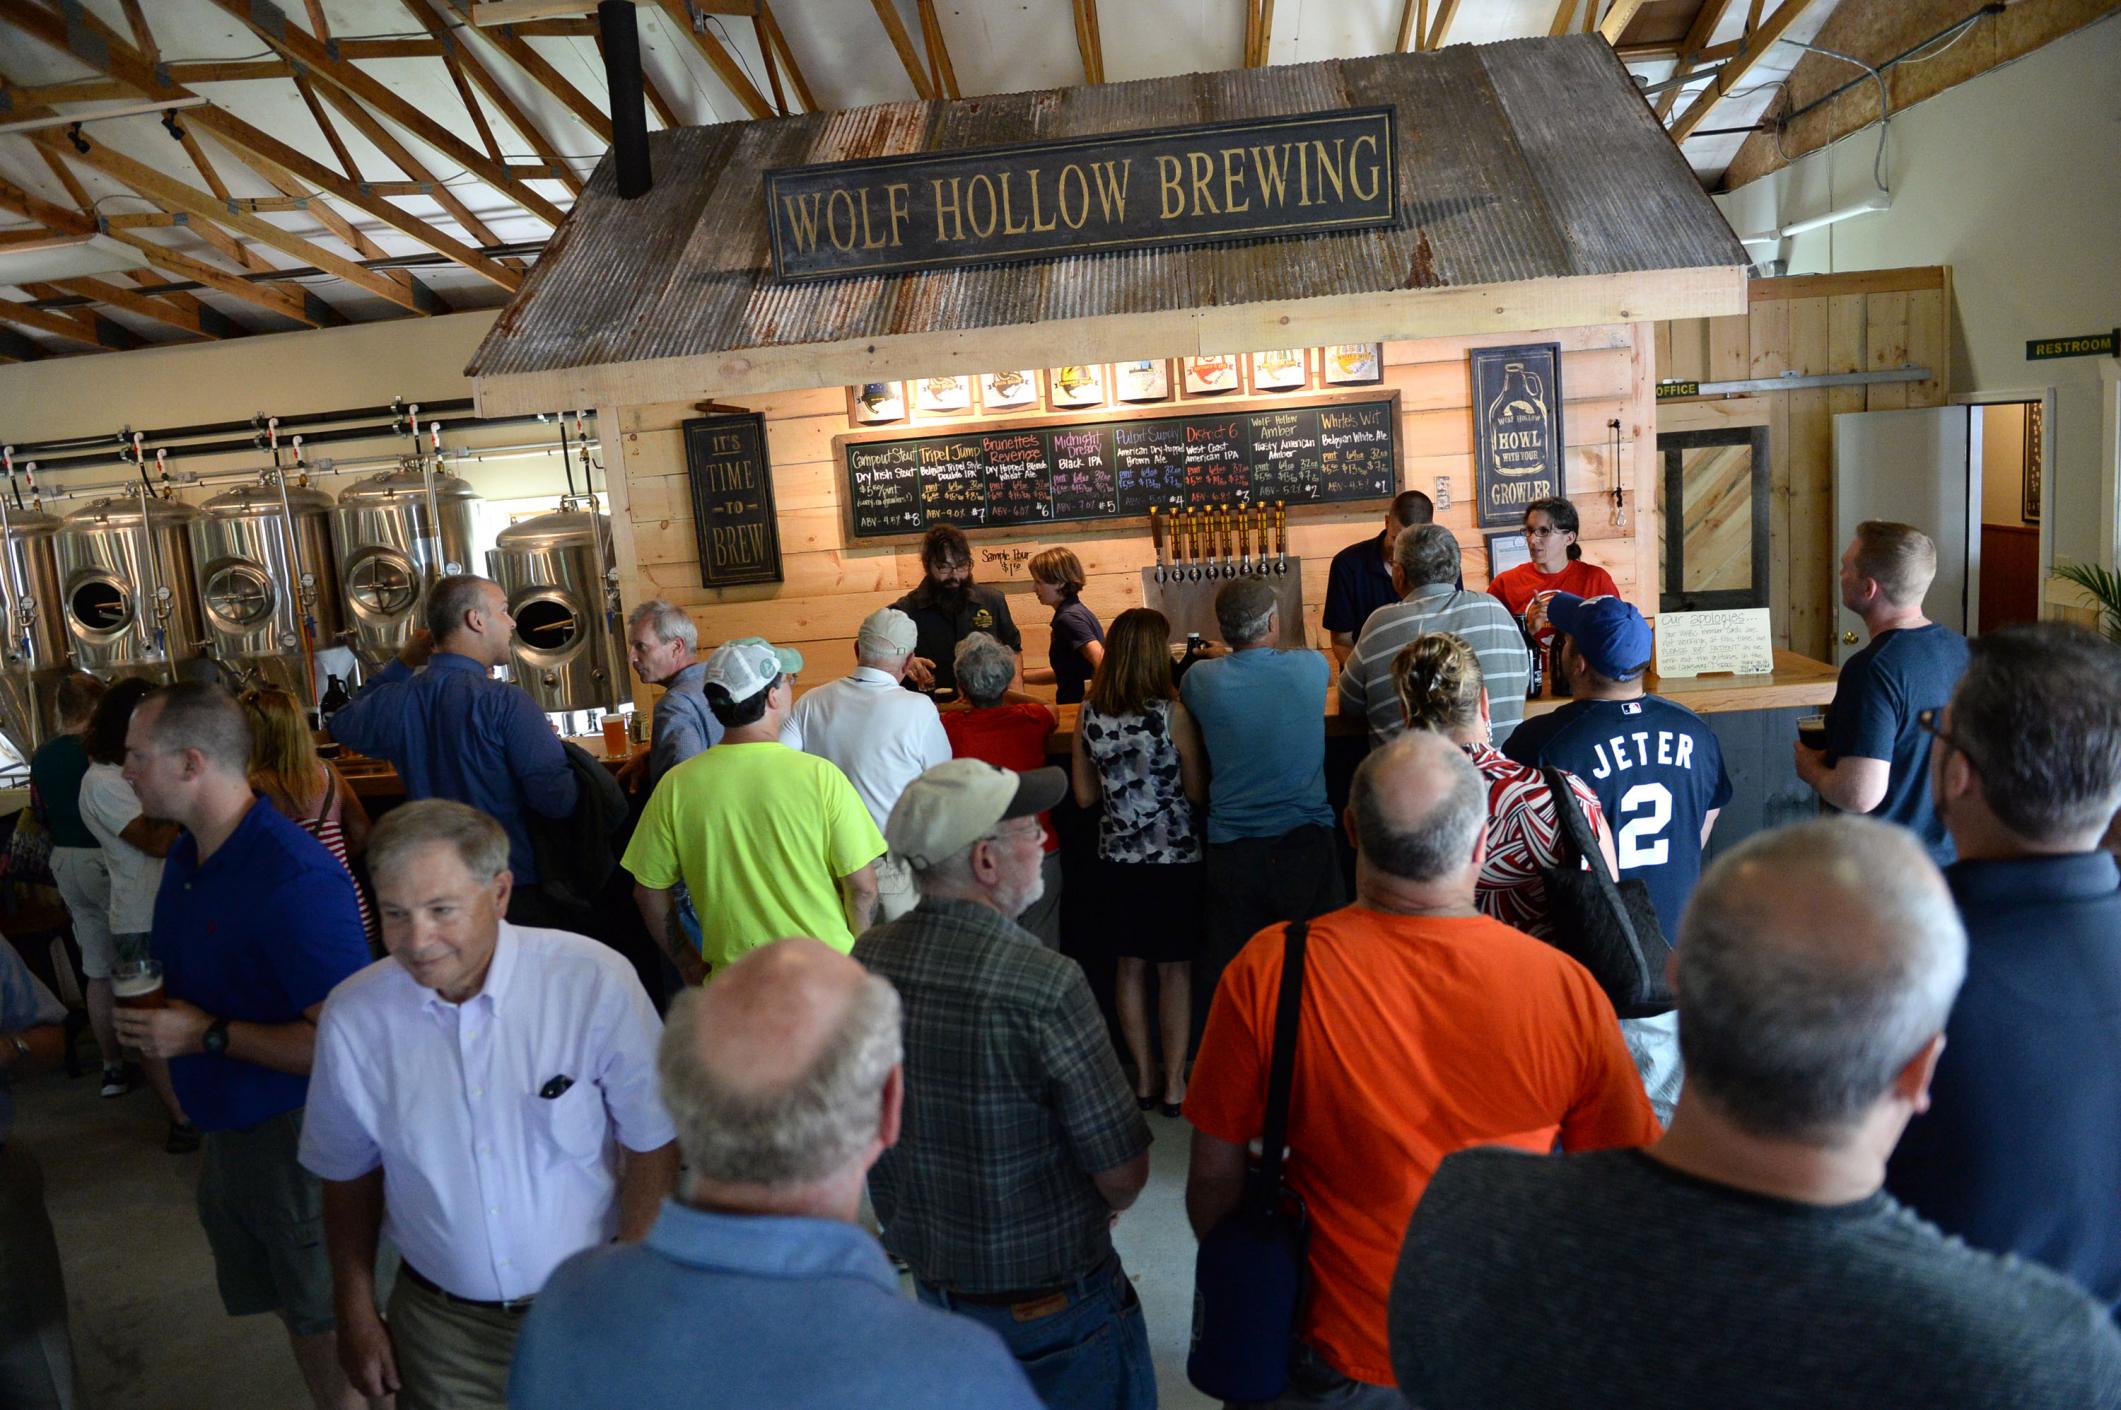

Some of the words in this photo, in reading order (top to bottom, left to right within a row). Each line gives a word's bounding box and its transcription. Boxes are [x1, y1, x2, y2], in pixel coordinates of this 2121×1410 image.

[783, 185, 911, 254] WOLF
[931, 158, 1132, 242] HOLLOW
[1155, 134, 1382, 220] BREWING
[2036, 338, 2112, 355] RESTROOM
[1656, 384, 1696, 396] OFFICE
[1251, 416, 1272, 427] Wolf
[1275, 414, 1298, 425] Hollow
[1360, 410, 1381, 426] Wit
[1498, 416, 1514, 425] WOLF
[1516, 415, 1541, 423] HOLLOW
[1186, 424, 1226, 443] District
[1228, 422, 1238, 439] 6
[1261, 425, 1297, 439] Amber
[1322, 434, 1352, 449] Belgian
[1353, 431, 1374, 443] White
[1375, 429, 1389, 441] Ale
[1498, 430, 1542, 449] HOWL
[712, 435, 741, 452] IT'S
[983, 435, 1039, 452] Brunette's
[1054, 431, 1104, 452] Midnight
[1186, 444, 1206, 455] West
[1208, 442, 1229, 453] Coast
[1281, 439, 1315, 450] American
[919, 446, 949, 467] Tripel
[952, 444, 980, 461] Jump
[990, 449, 1041, 464] Revenge
[1067, 443, 1102, 459] Dreary
[1117, 447, 1148, 457] American
[1185, 453, 1220, 464] American
[1224, 451, 1239, 460] IPA
[1269, 450, 1297, 460] Amber
[1503, 452, 1520, 461] WITH
[1520, 450, 1538, 460] YOUR
[852, 449, 892, 470] Campout
[892, 448, 918, 463] Stout
[1058, 458, 1085, 470] Black
[1088, 456, 1103, 467] IPA
[1126, 456, 1150, 468] Brown
[1154, 455, 1168, 464] Ale
[706, 460, 755, 492] TIME
[920, 465, 946, 476] Belgian
[946, 461, 965, 472] Tripel
[938, 472, 962, 481] Double
[964, 470, 977, 478] IPA
[986, 465, 998, 477] Dry
[1000, 461, 1024, 474] Hopped
[856, 473, 871, 486] Dry
[873, 469, 892, 481] Irish
[895, 467, 917, 479] Stout
[1000, 472, 1023, 481] Wheat
[1305, 484, 1320, 499] #2
[1375, 480, 1388, 494] #1
[1491, 480, 1551, 505] GROWLER
[1169, 495, 1184, 509] #4
[1236, 489, 1250, 504] #3
[725, 501, 744, 514] TO
[1036, 501, 1049, 517] #6
[1099, 500, 1116, 513] #5
[904, 512, 920, 527] #8
[971, 507, 985, 524] #7
[712, 522, 764, 566] BREW
[982, 549, 1010, 566] Sample
[1013, 548, 1033, 560] Pour
[1661, 614, 1684, 626] Our
[1593, 731, 1694, 779] JETER
[1618, 782, 1673, 869] 2
